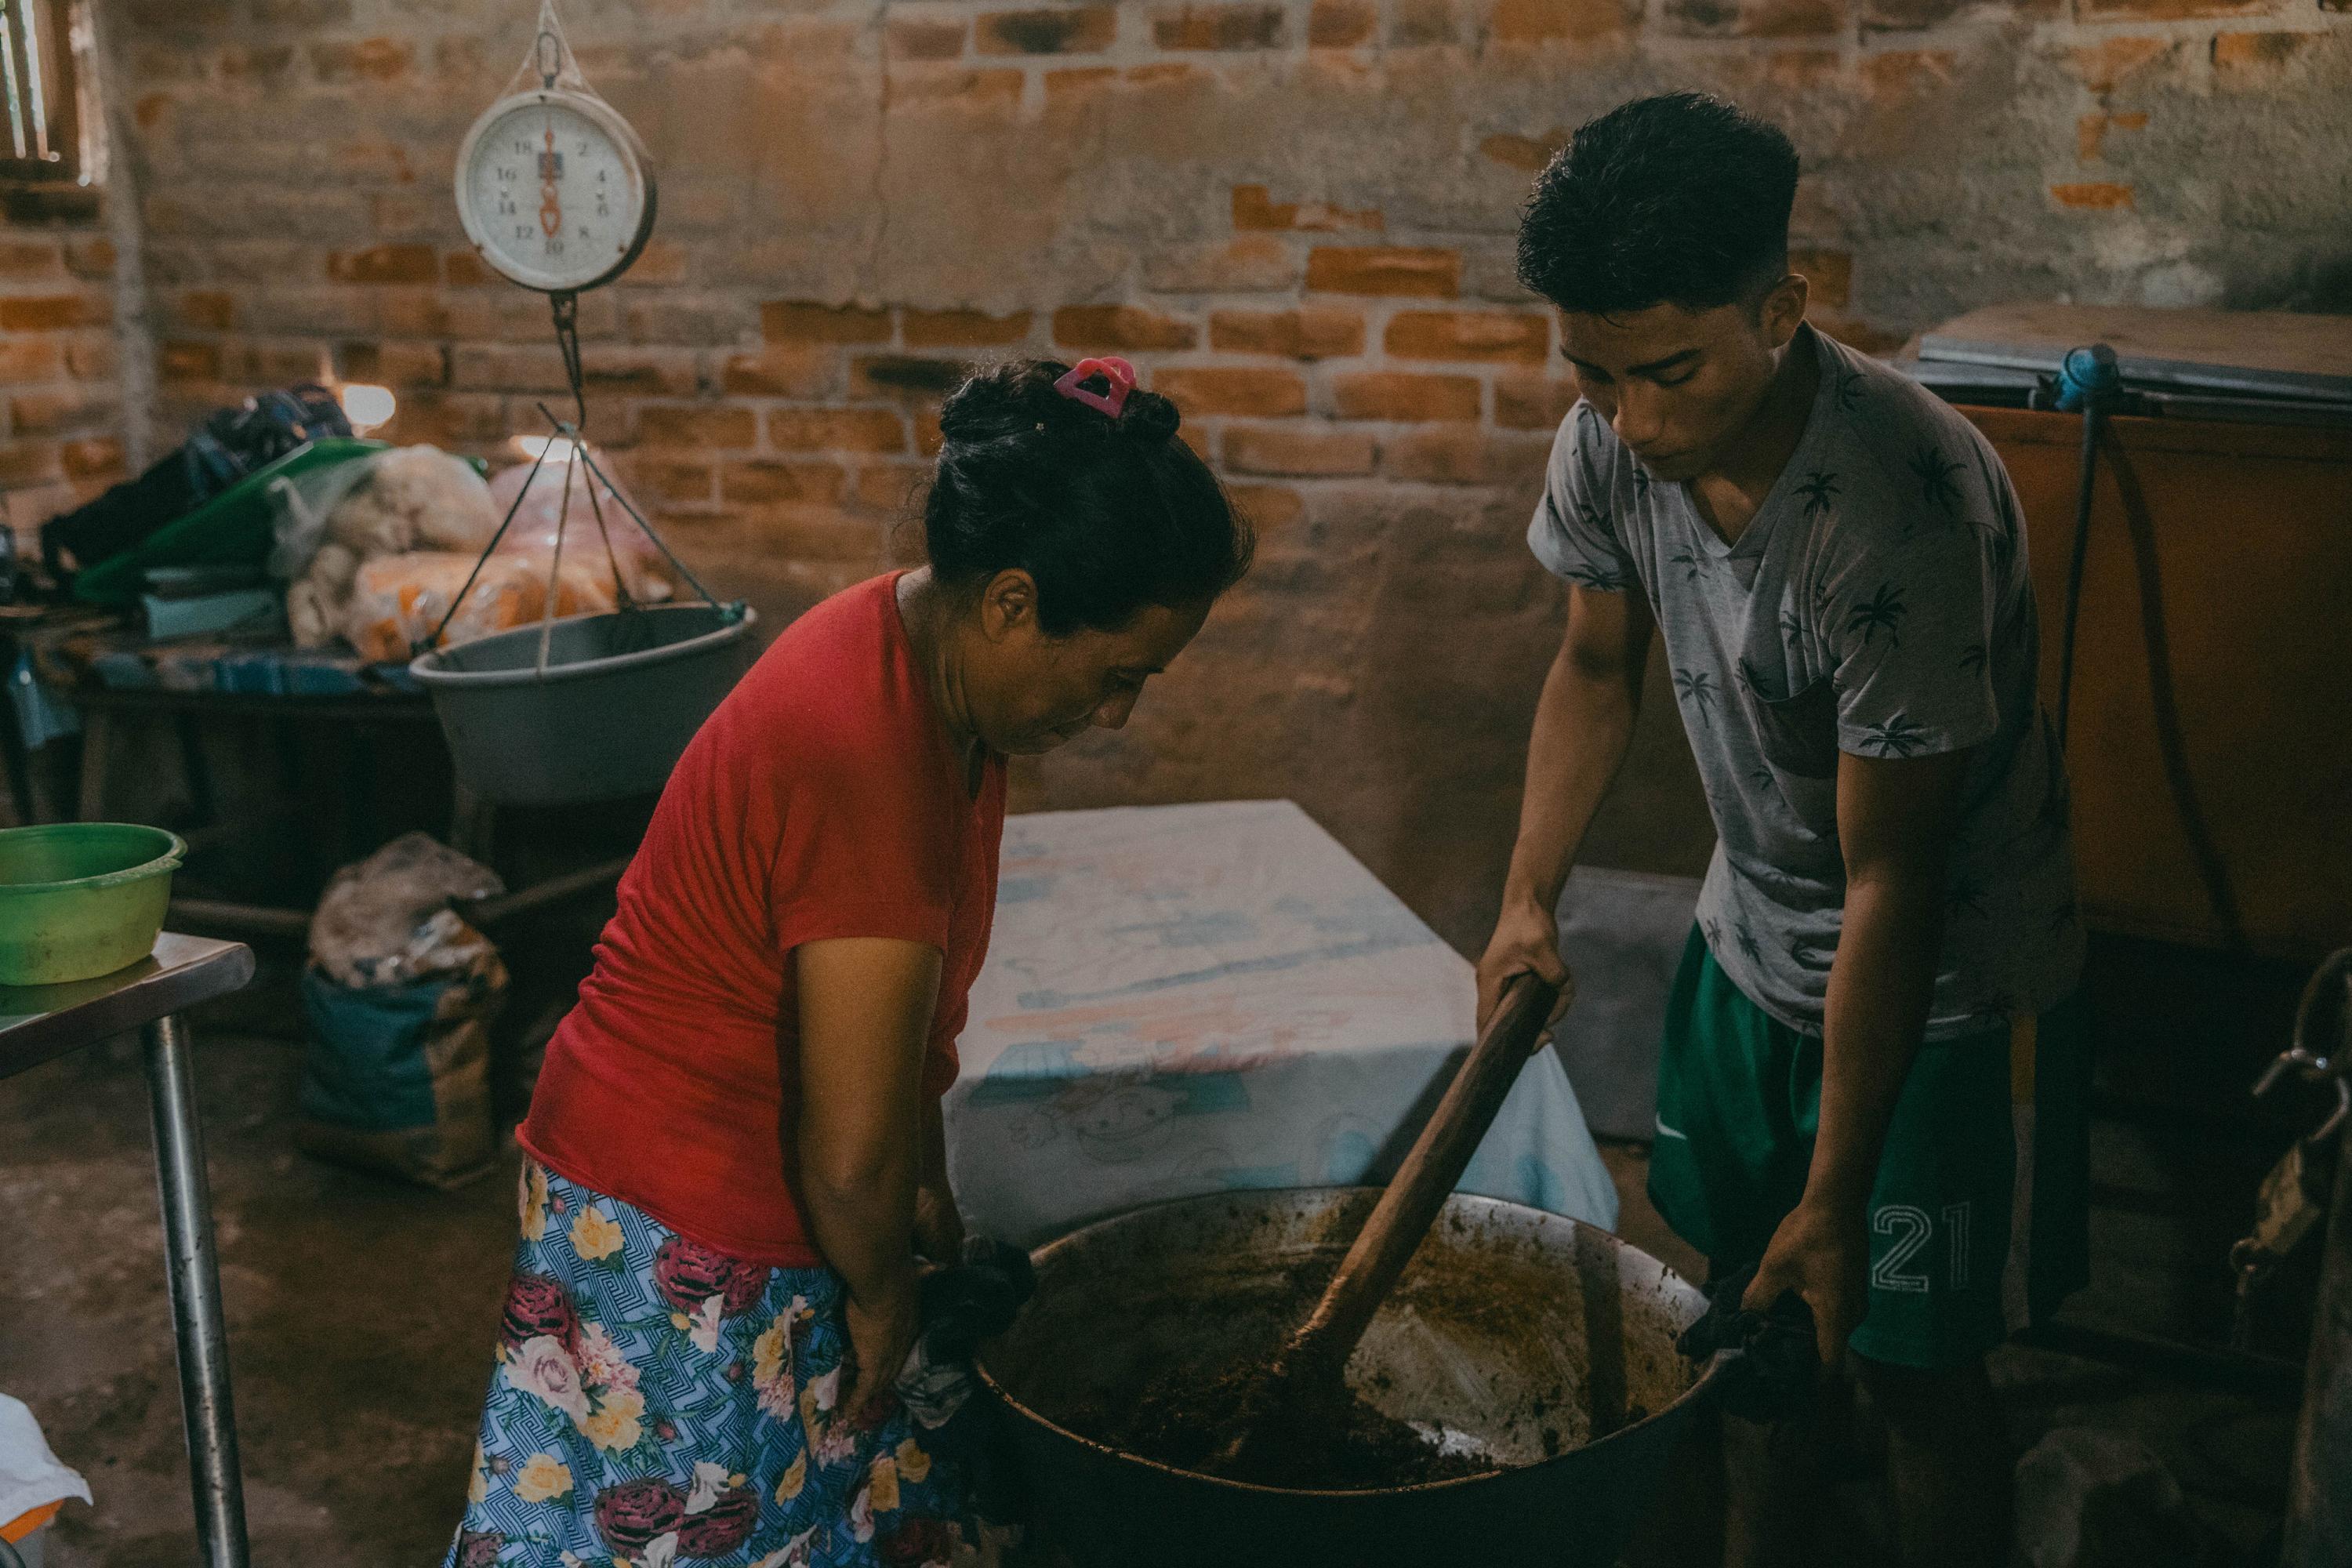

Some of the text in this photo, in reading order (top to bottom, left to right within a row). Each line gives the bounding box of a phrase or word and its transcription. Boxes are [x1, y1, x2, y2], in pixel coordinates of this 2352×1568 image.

[514, 140, 532, 155] 18
[578, 143, 587, 157] 2
[497, 167, 517, 182] 16
[599, 169, 607, 182] 4
[516, 224, 534, 240] 12
[544, 240, 564, 255] 10
[1871, 1201, 1970, 1293] 21
